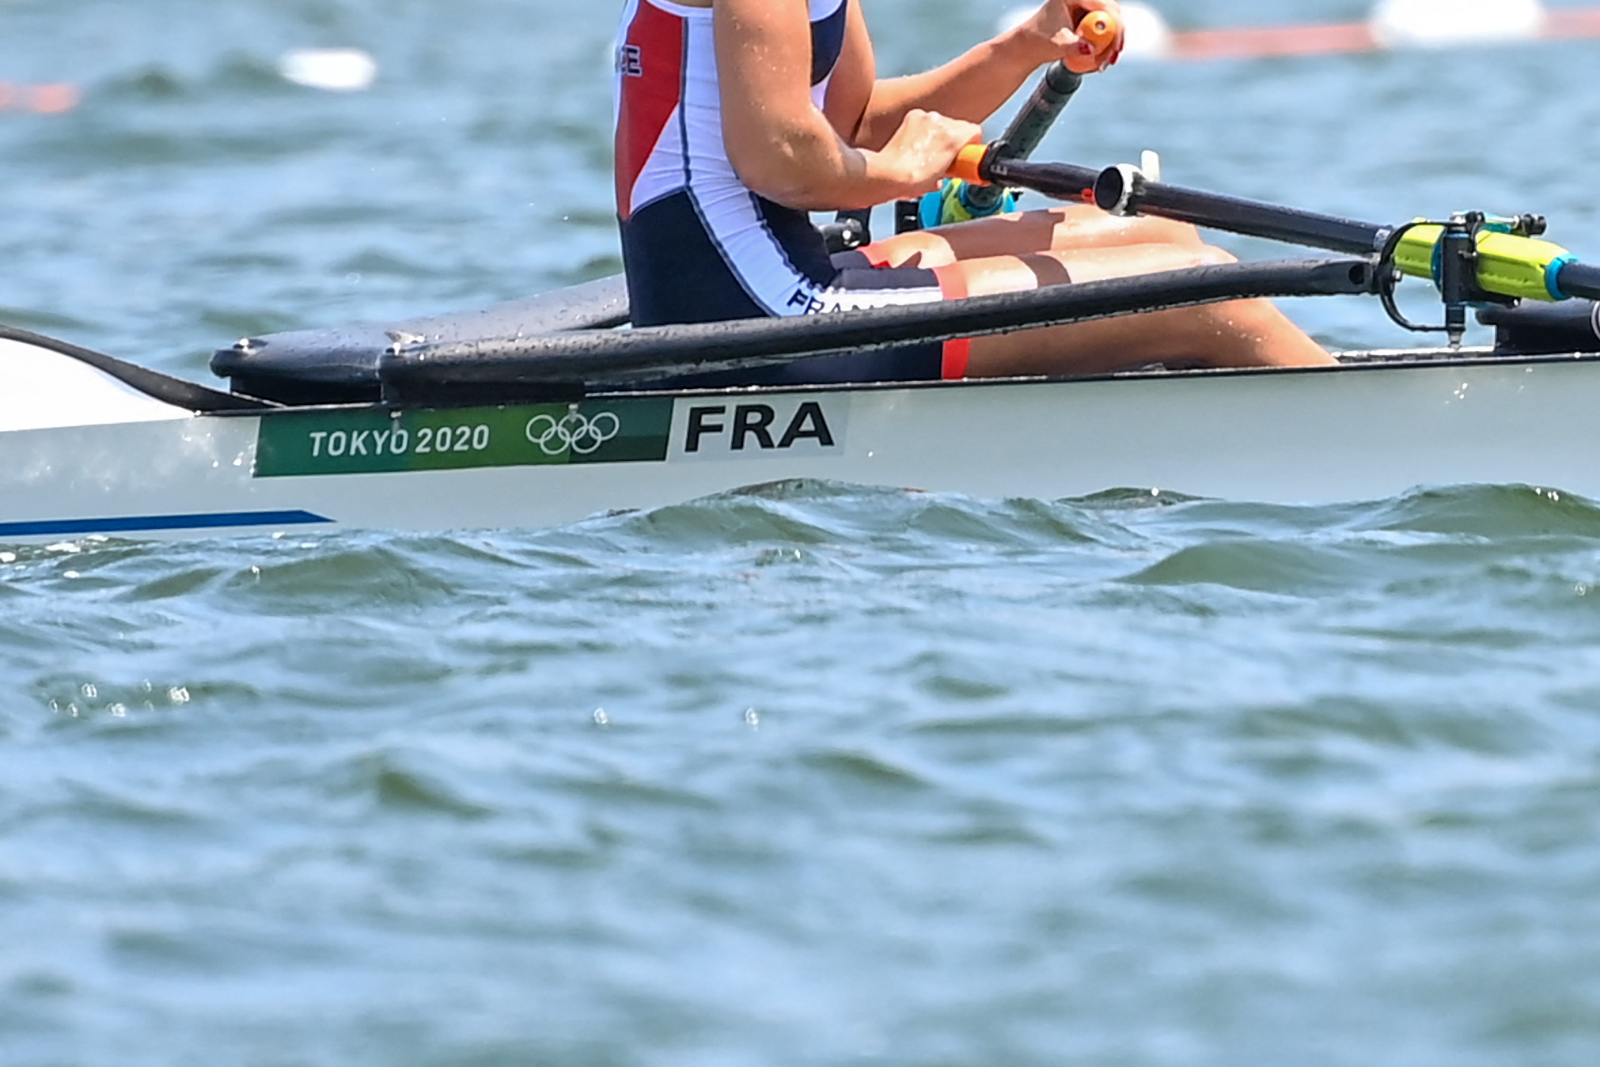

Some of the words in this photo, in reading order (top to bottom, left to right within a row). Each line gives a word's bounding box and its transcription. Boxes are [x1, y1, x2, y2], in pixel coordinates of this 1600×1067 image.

[308, 428, 410, 457] TOKYO
[414, 424, 491, 454] 2020
[684, 401, 835, 453] FRA
